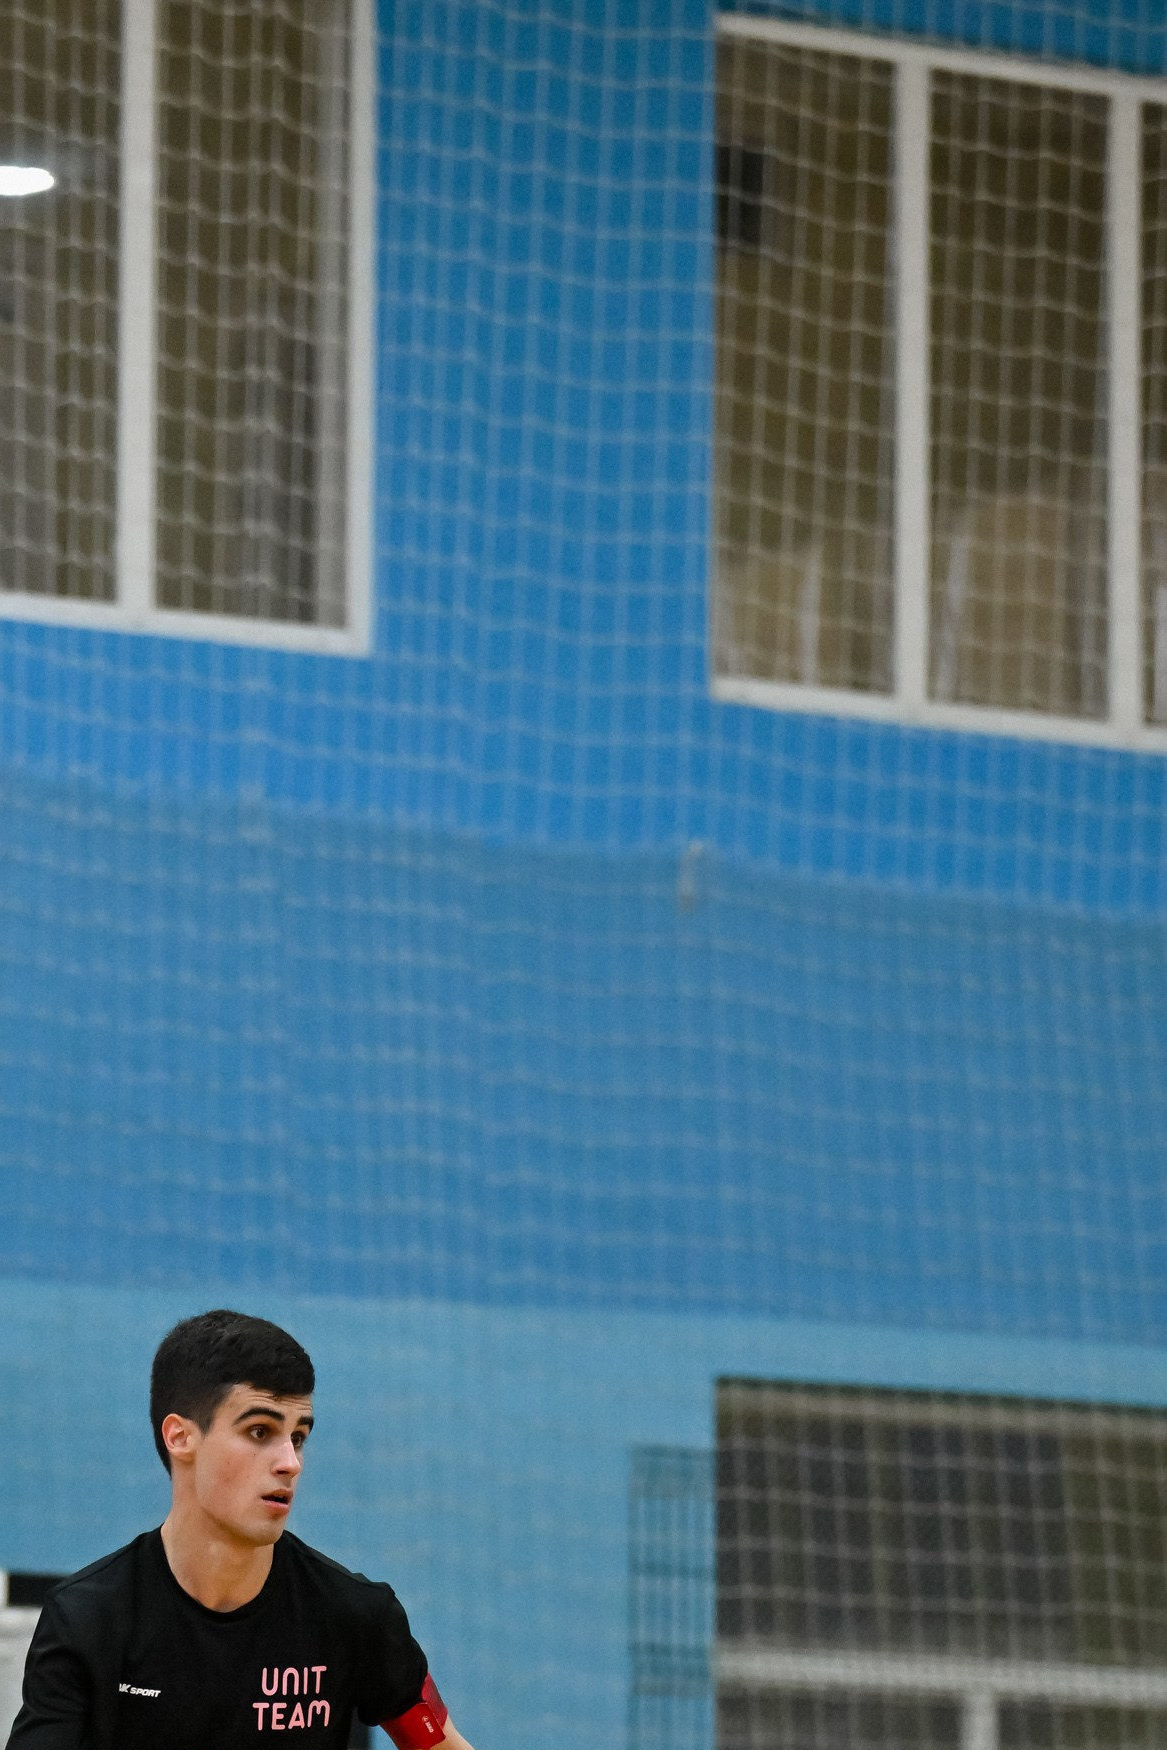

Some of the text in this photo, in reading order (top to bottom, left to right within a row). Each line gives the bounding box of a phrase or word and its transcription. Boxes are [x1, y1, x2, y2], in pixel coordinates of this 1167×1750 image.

[129, 1686, 161, 1698] SPORT
[261, 1665, 327, 1696] UNIT
[252, 1699, 331, 1731] TEAM
